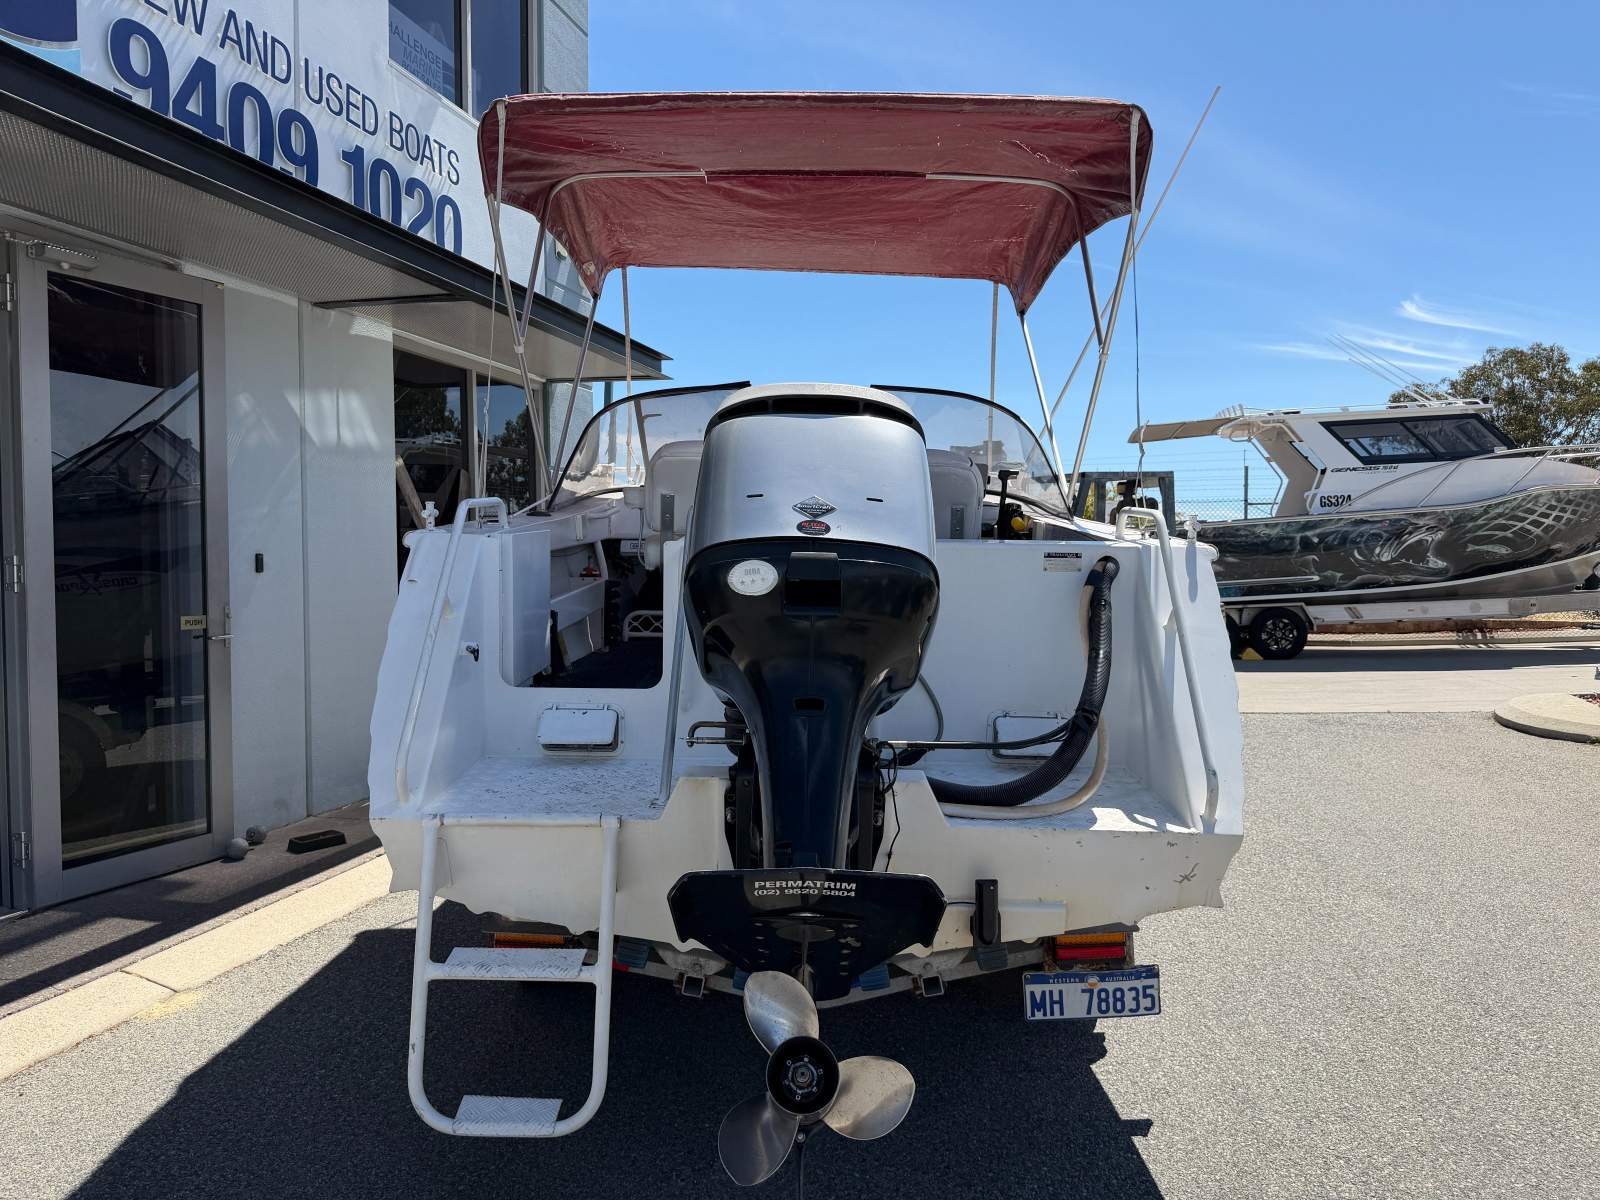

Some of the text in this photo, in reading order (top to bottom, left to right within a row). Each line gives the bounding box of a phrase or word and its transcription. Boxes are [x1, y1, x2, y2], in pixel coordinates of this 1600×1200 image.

[219, 9, 291, 84] AND
[304, 57, 378, 136] USED
[389, 110, 460, 185] BOATS
[109, 17, 463, 257] 9409 1020
[754, 880, 857, 890] PERMATRIM
[754, 889, 780, 897] (02)
[822, 889, 856, 897] 5804
[1029, 984, 1156, 1018] MH 78835
